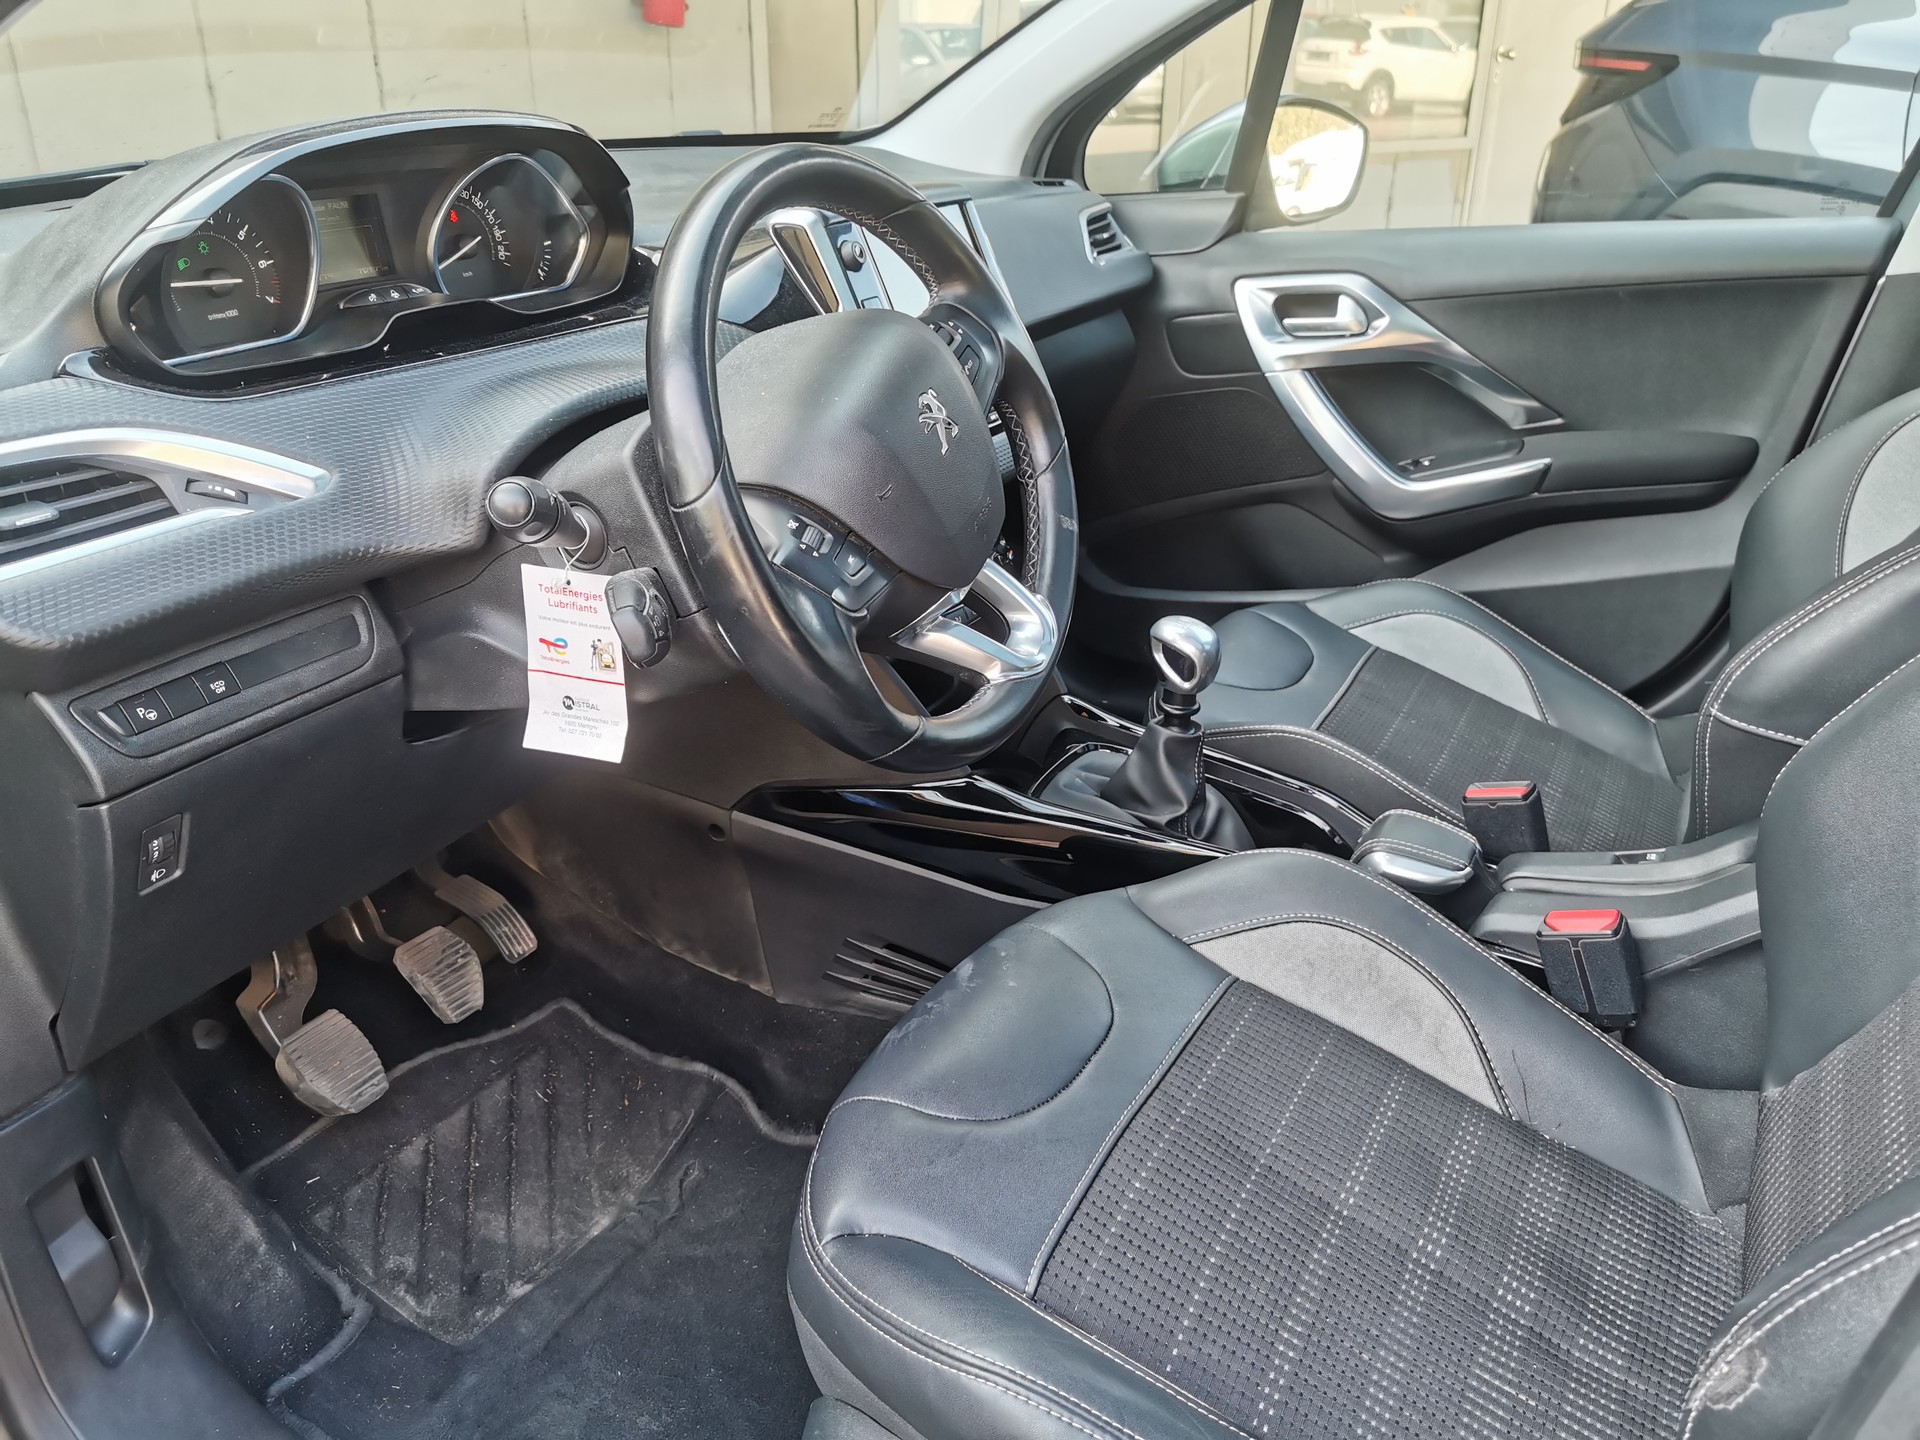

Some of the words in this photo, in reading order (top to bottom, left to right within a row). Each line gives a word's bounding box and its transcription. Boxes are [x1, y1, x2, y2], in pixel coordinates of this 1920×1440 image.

[471, 196, 483, 209] 150
[485, 209, 495, 224] 170
[237, 231, 246, 240] 5
[258, 260, 267, 268] 6
[265, 295, 274, 303] 7
[538, 583, 603, 601] TotalEnergies
[548, 598, 598, 614] Lubrifiants
[210, 680, 225, 690] ECO
[215, 685, 226, 694] OFF
[136, 707, 145, 719] P
